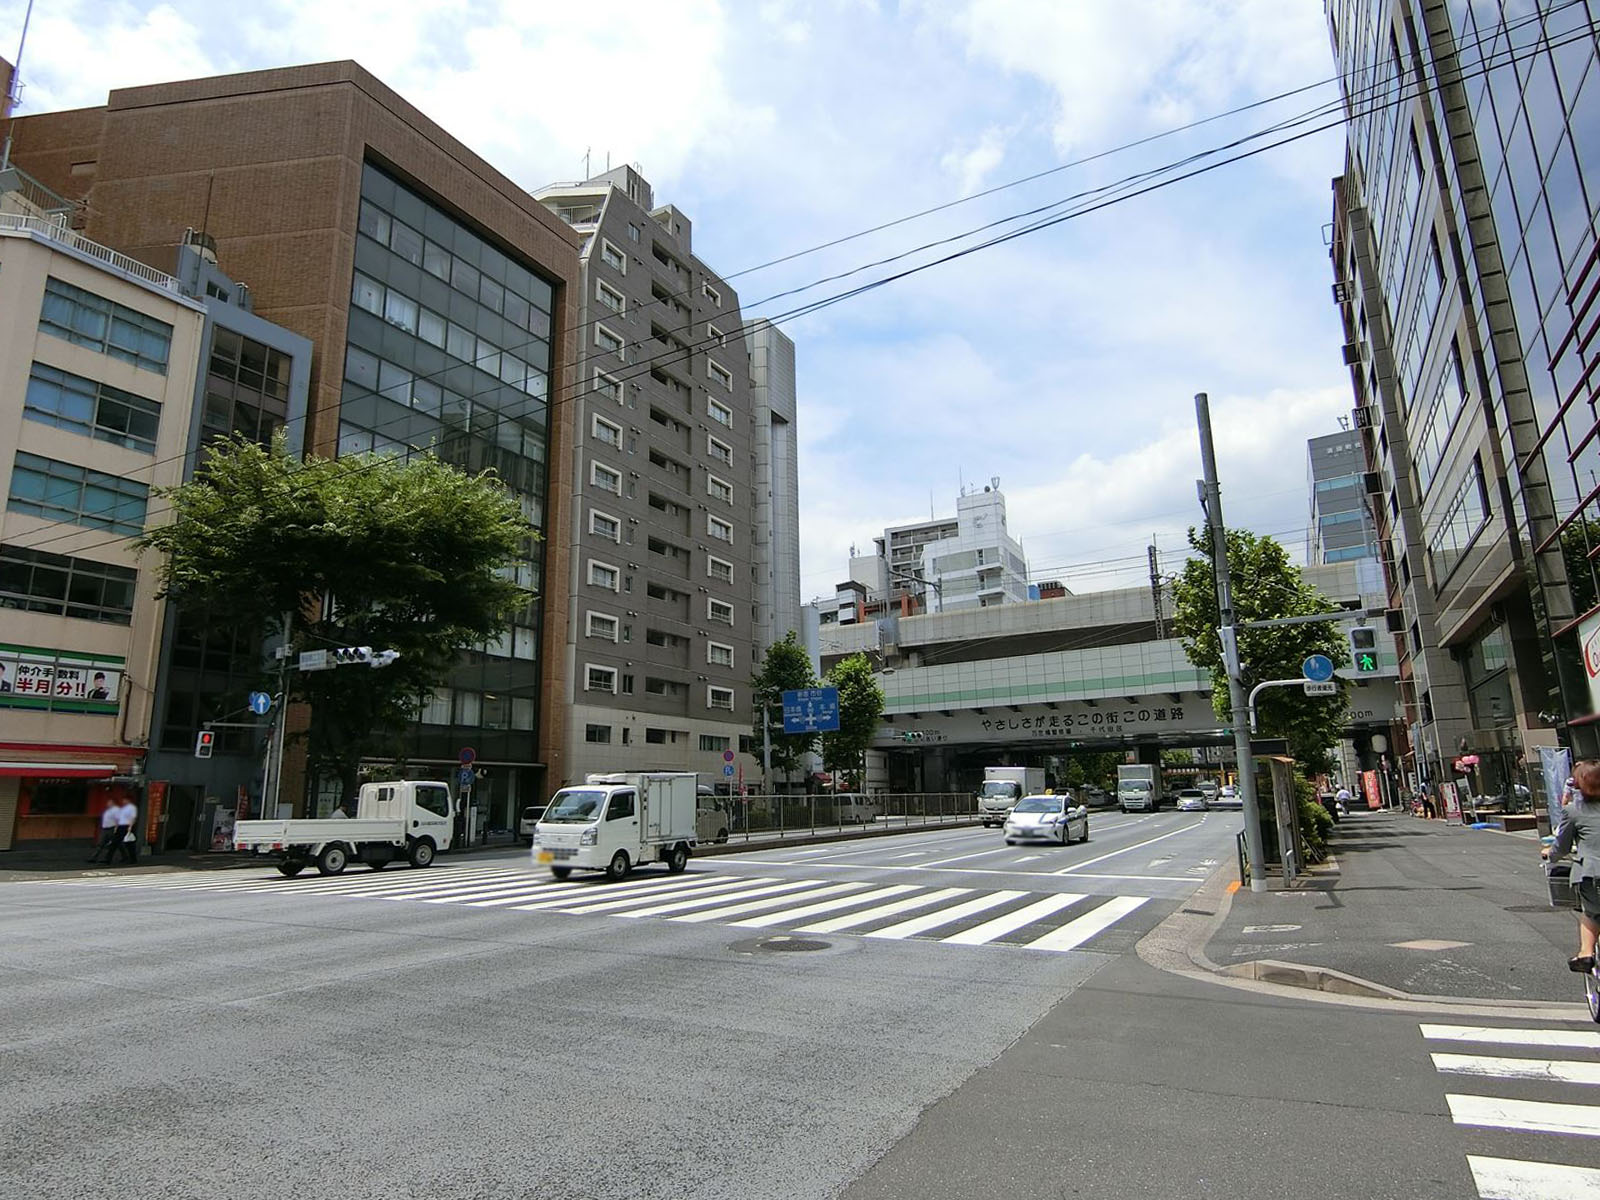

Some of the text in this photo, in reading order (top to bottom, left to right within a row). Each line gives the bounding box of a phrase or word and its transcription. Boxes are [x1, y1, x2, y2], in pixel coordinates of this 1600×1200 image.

[18, 665, 80, 681] 仲介手数料
[1090, 725, 1123, 734] 千代田区
